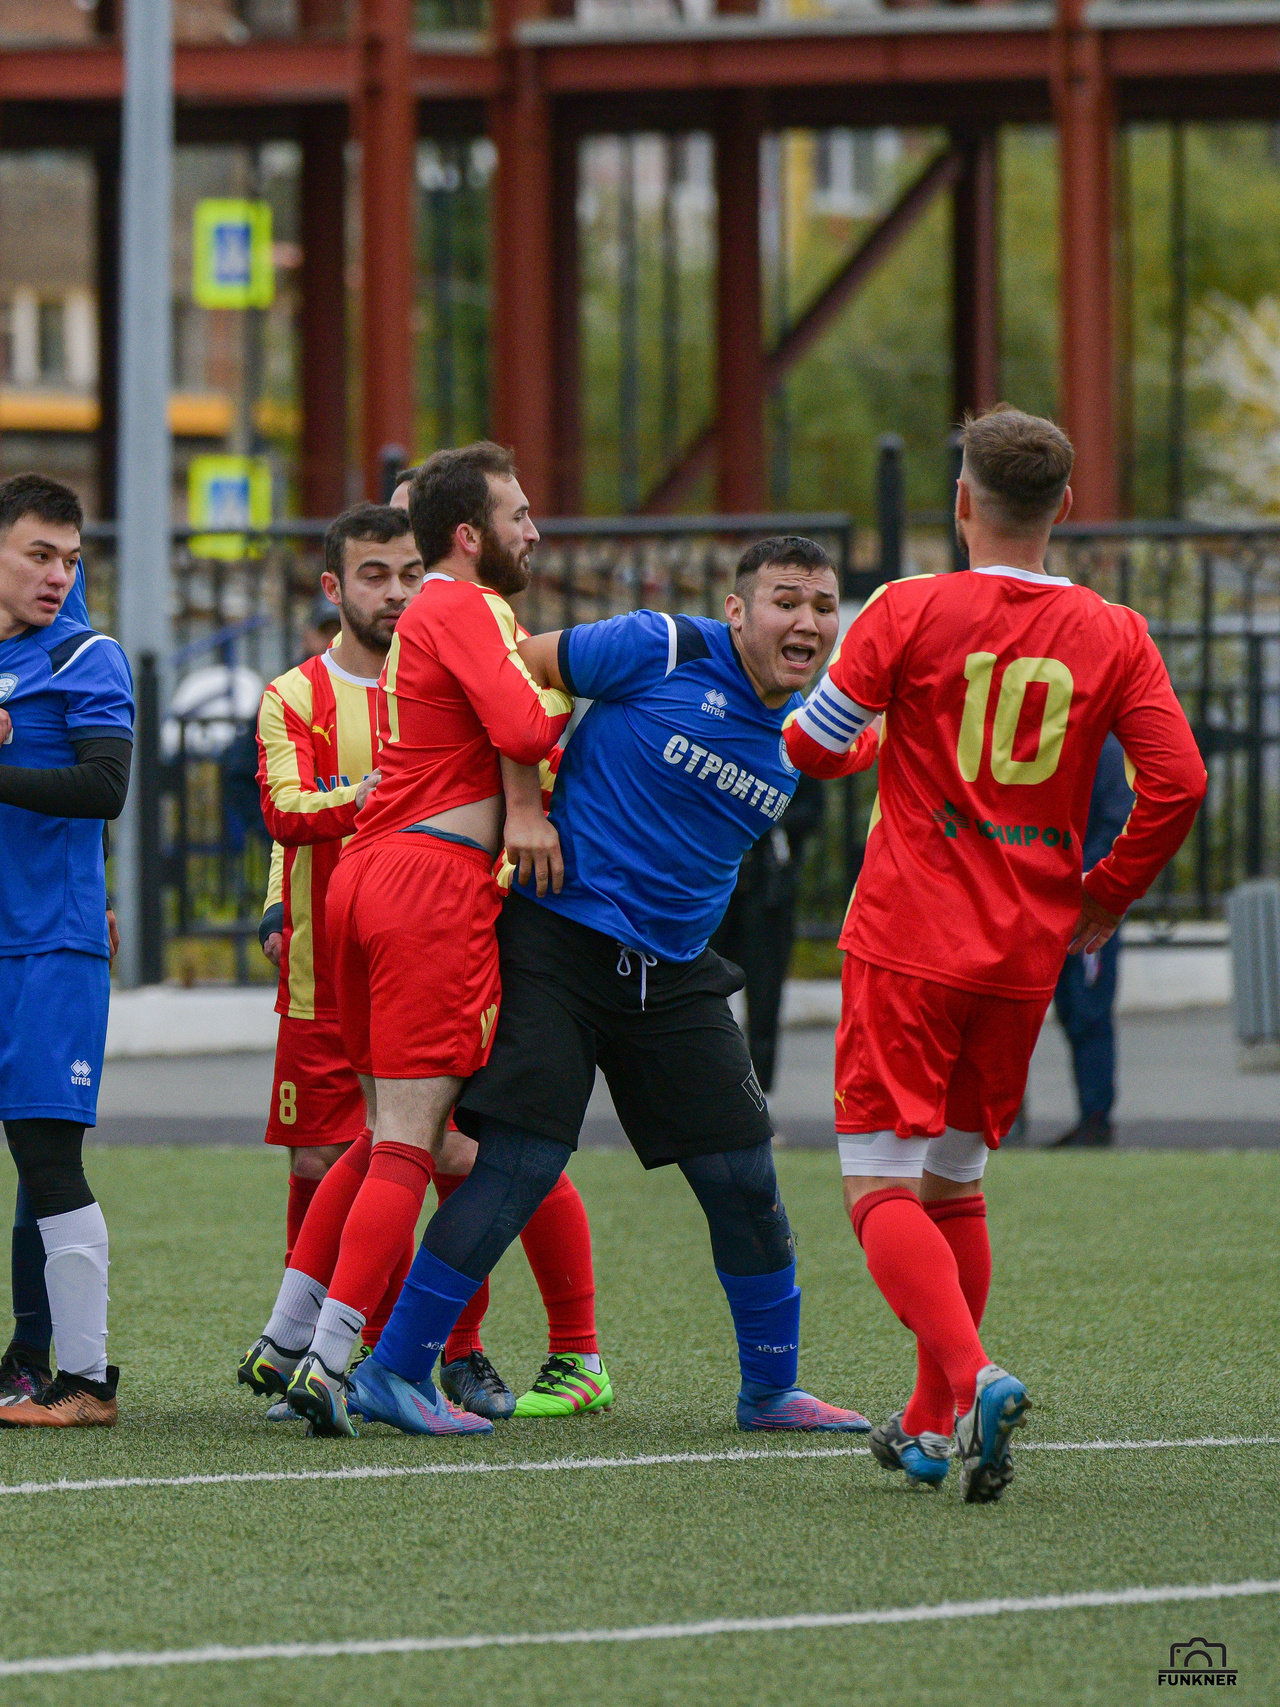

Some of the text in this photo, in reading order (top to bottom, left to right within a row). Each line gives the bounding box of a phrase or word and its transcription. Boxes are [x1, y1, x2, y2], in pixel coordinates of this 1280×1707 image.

[701, 702, 726, 719] errea
[957, 651, 1074, 785] 10
[662, 734, 791, 822] СТРОИТЕЛ
[70, 1075, 91, 1087] errea
[279, 1080, 297, 1125] 8
